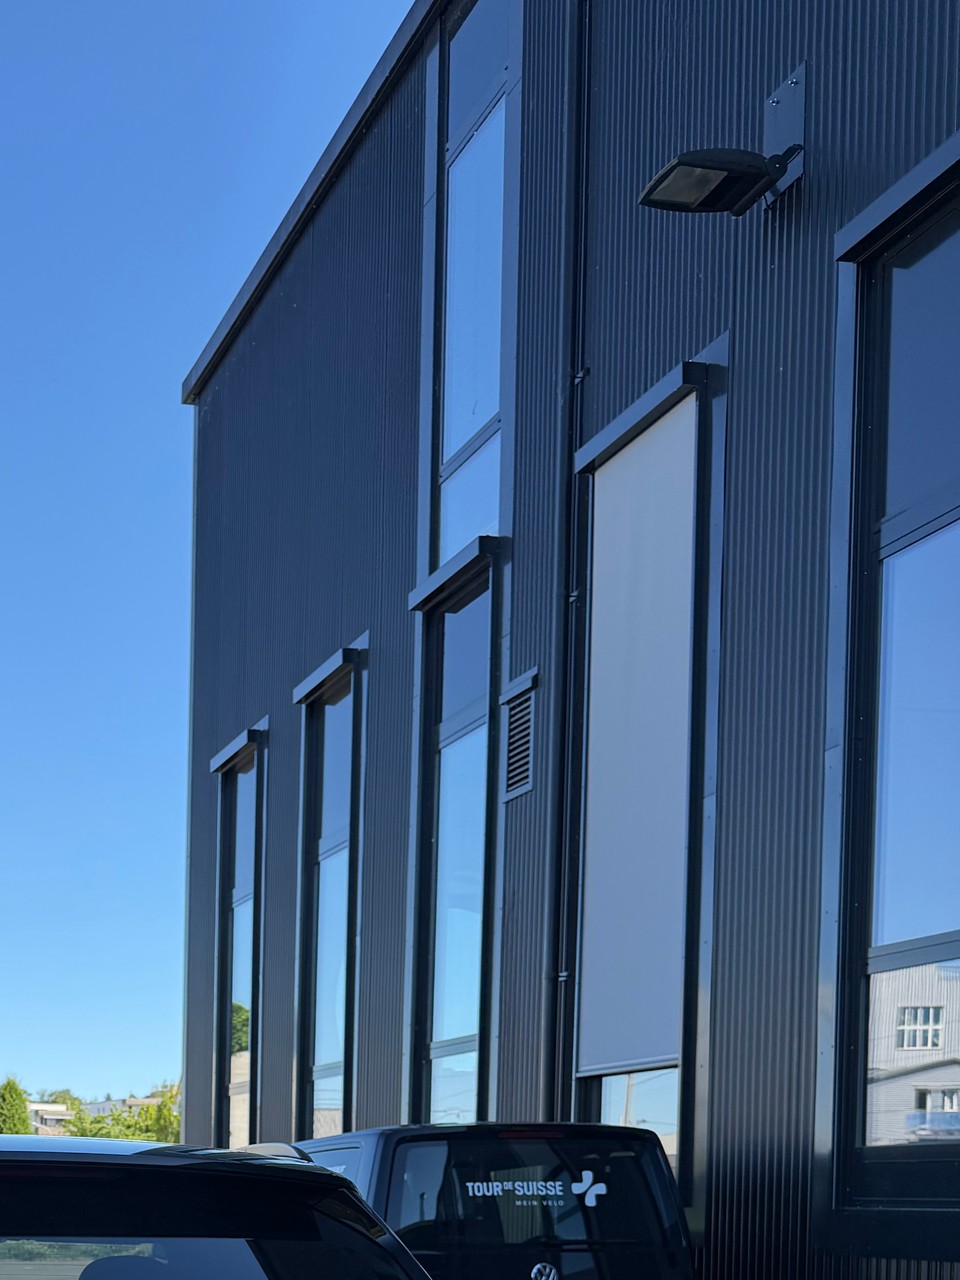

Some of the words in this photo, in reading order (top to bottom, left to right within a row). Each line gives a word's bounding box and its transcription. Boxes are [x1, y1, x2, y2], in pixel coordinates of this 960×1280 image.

[466, 1182, 503, 1196] TOUR
[503, 1182, 513, 1190] DE
[514, 1181, 564, 1196] SUISSE
[542, 1199, 564, 1207] VELO
